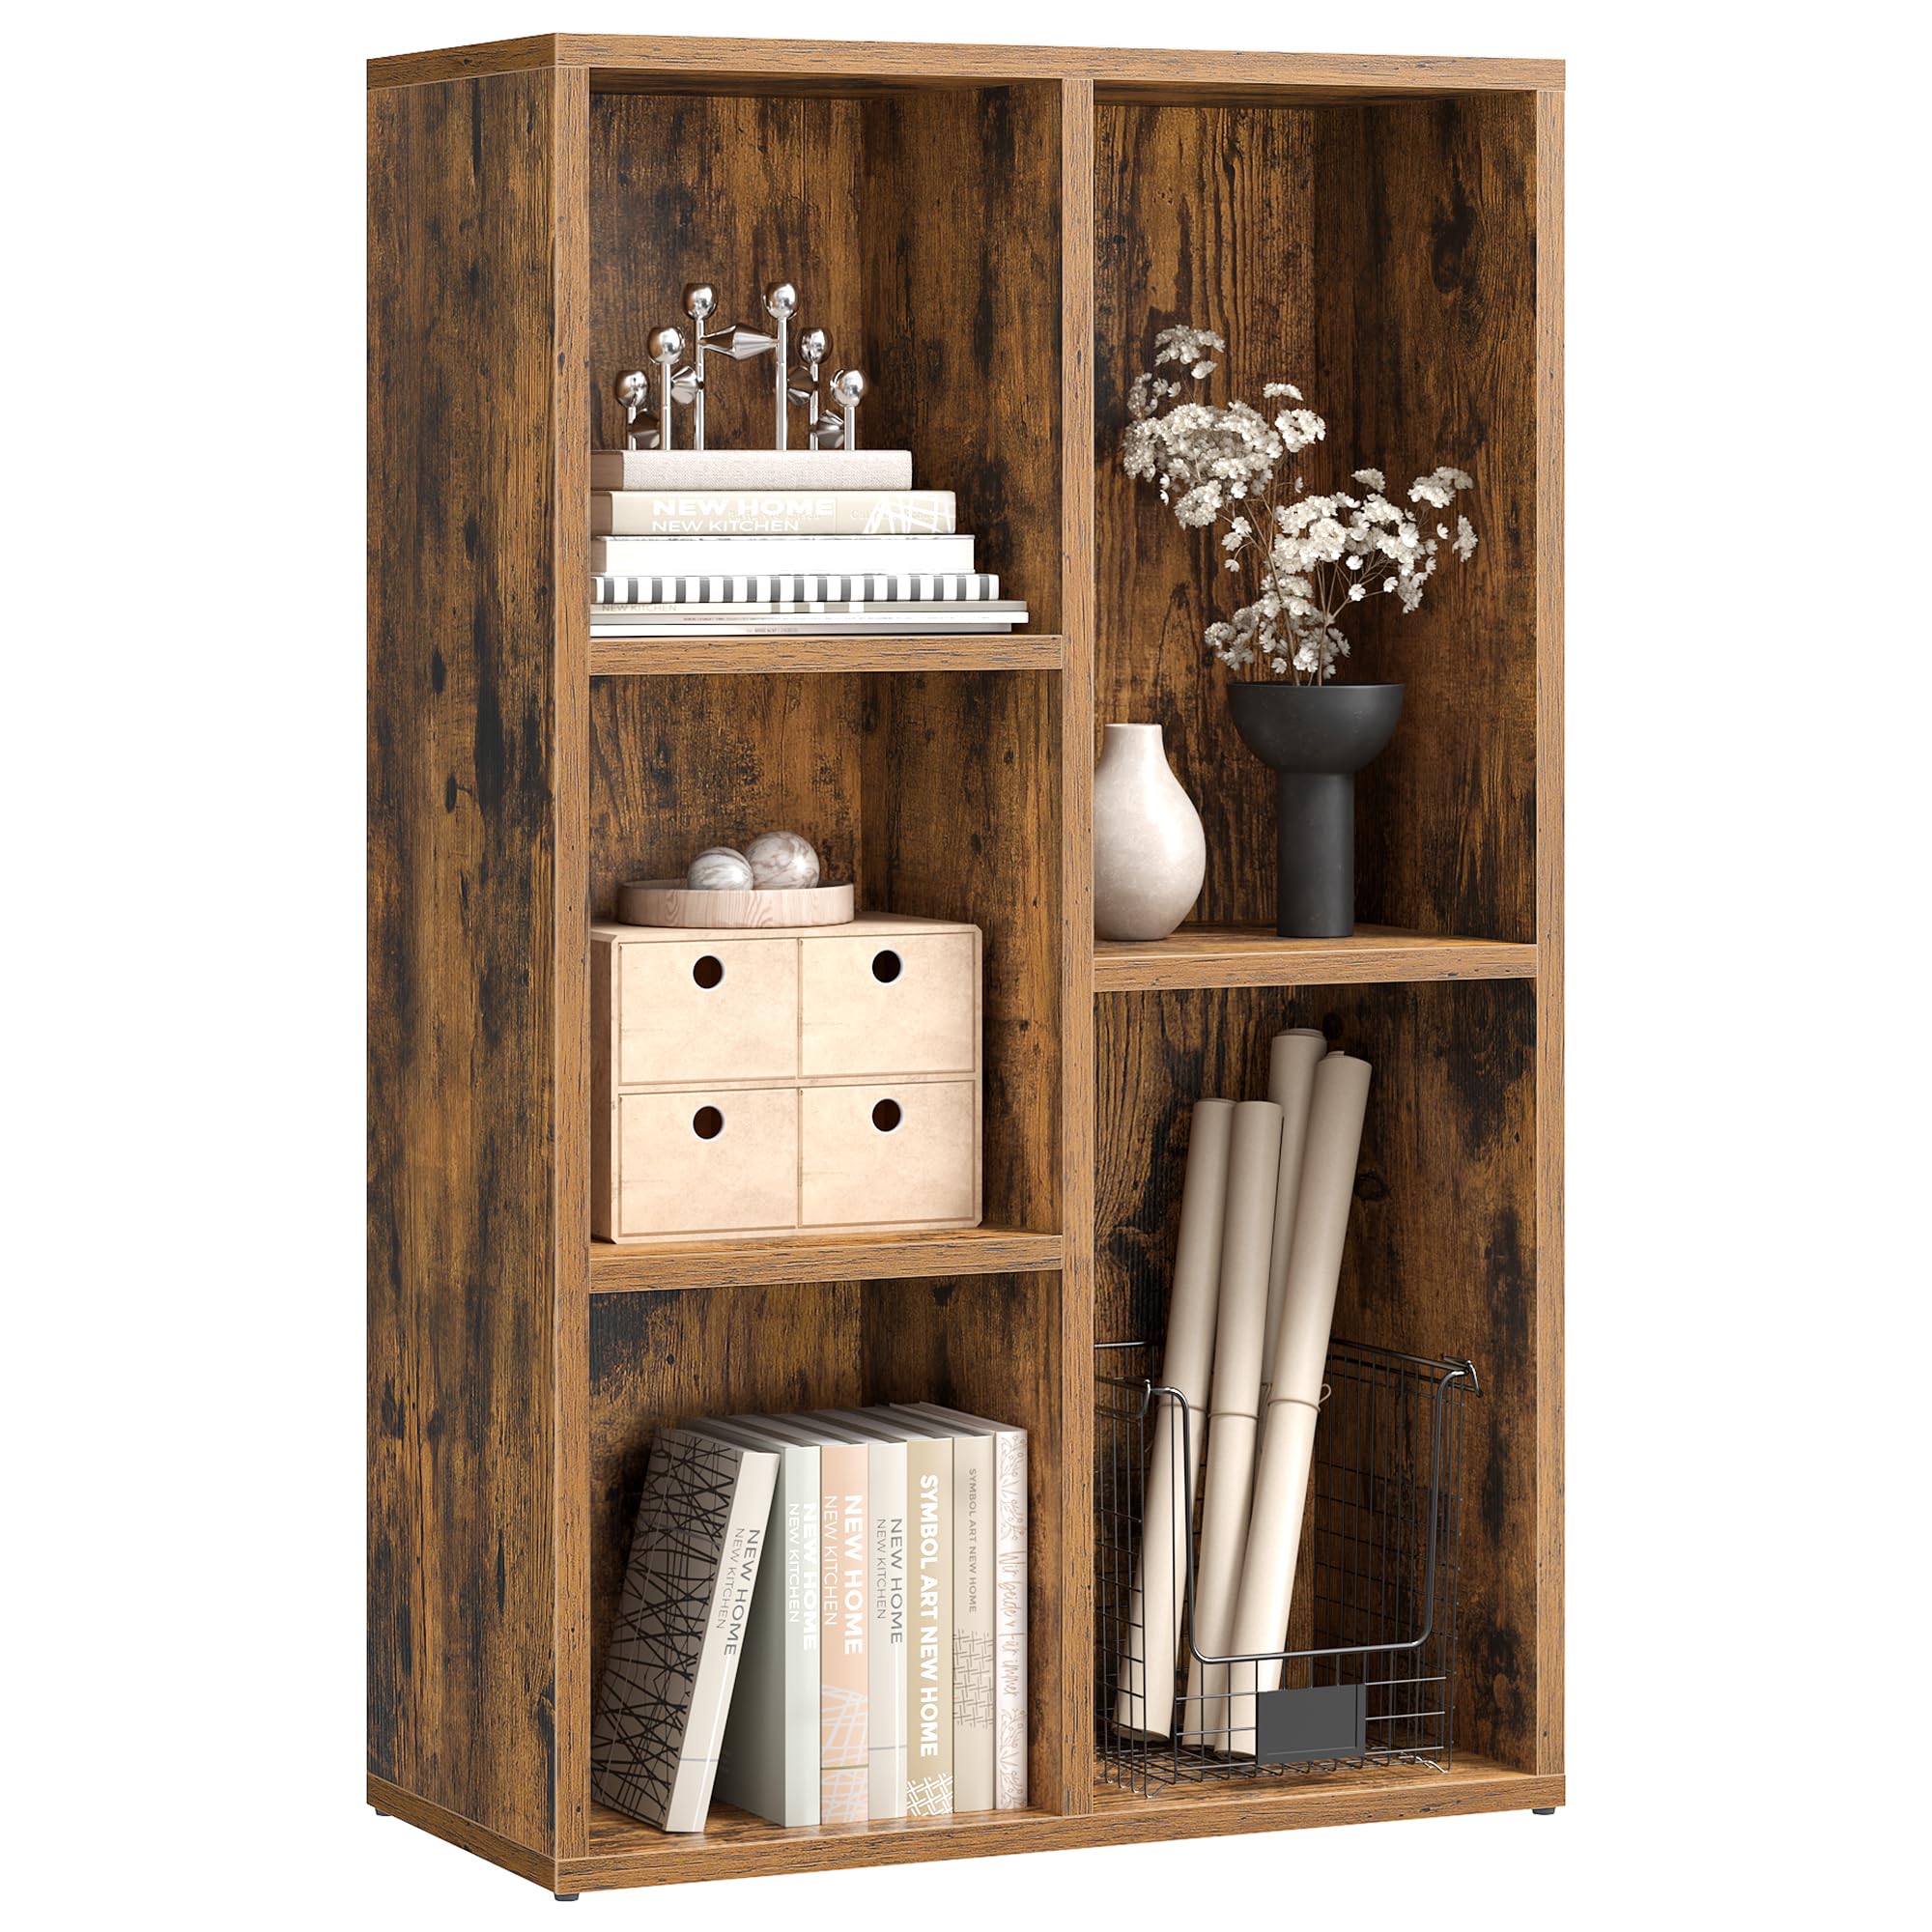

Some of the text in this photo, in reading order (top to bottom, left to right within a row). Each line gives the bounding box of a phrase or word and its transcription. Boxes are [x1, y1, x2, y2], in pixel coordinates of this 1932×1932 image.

[652, 498, 728, 516] NEW
[738, 497, 835, 516] HOME
[652, 520, 799, 532] NEW KITCHEN
[717, 1527, 745, 1630] NEW KITCHEN
[724, 1529, 760, 1656] NEW HOME
[789, 1503, 799, 1622] NEW KITCHEN
[803, 1503, 817, 1651] NEW HOME
[824, 1495, 838, 1626] NEW KITCHEN
[844, 1495, 863, 1654] NEW HOME
[877, 1519, 886, 1619] NEW KITCHEN
[891, 1519, 902, 1644] NEW HOME
[920, 1474, 939, 1757] SYMBOL ART NEW HOME
[998, 1581, 1022, 1617] beide
[999, 1550, 1026, 1577] Wir
[1002, 1660, 1020, 1698] immer
